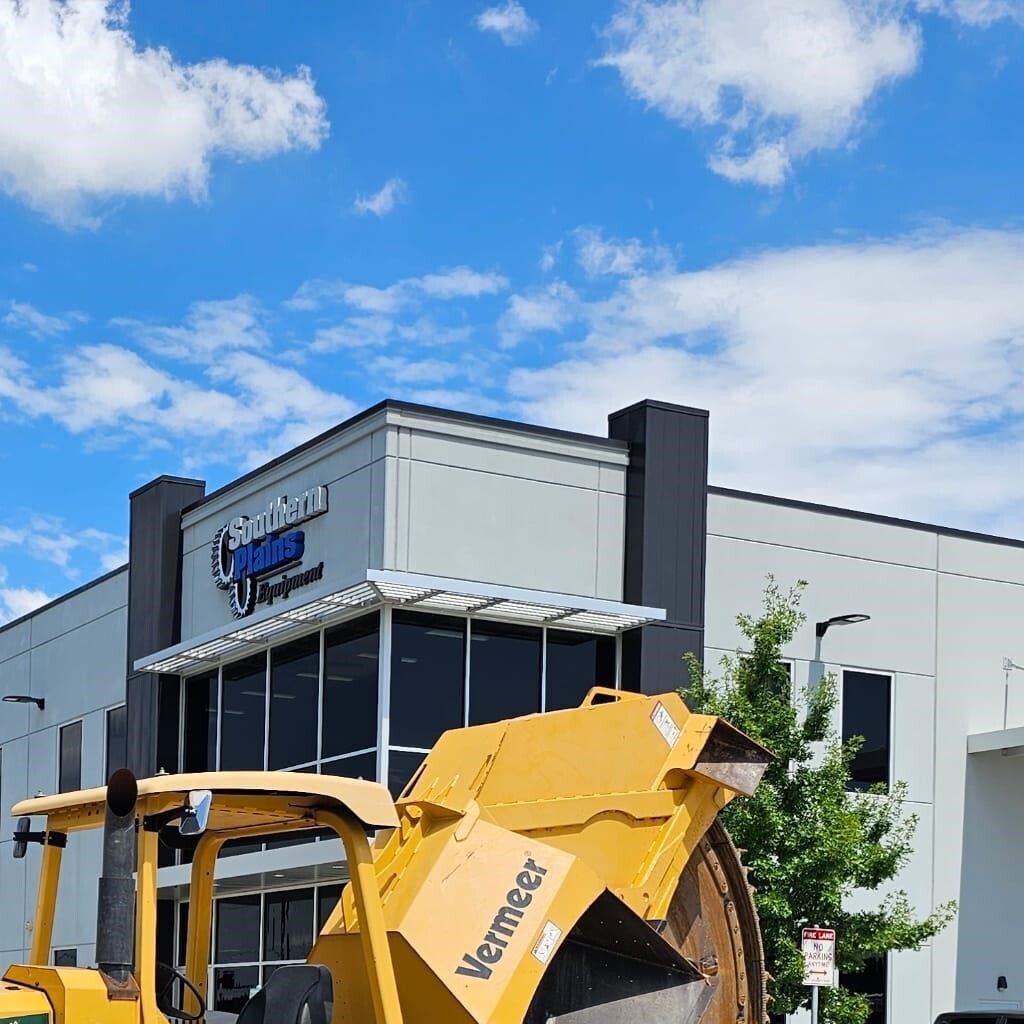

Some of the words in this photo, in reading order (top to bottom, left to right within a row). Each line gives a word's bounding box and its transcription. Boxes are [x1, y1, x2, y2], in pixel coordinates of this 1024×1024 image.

[228, 485, 328, 550] Southern
[233, 531, 304, 583] Plains
[257, 562, 324, 605] Equipment
[454, 857, 548, 980] Vermeer
[803, 931, 817, 939] FIRE
[818, 932, 834, 940] LANE
[805, 952, 833, 961] PARKING
[813, 943, 824, 952] NO
